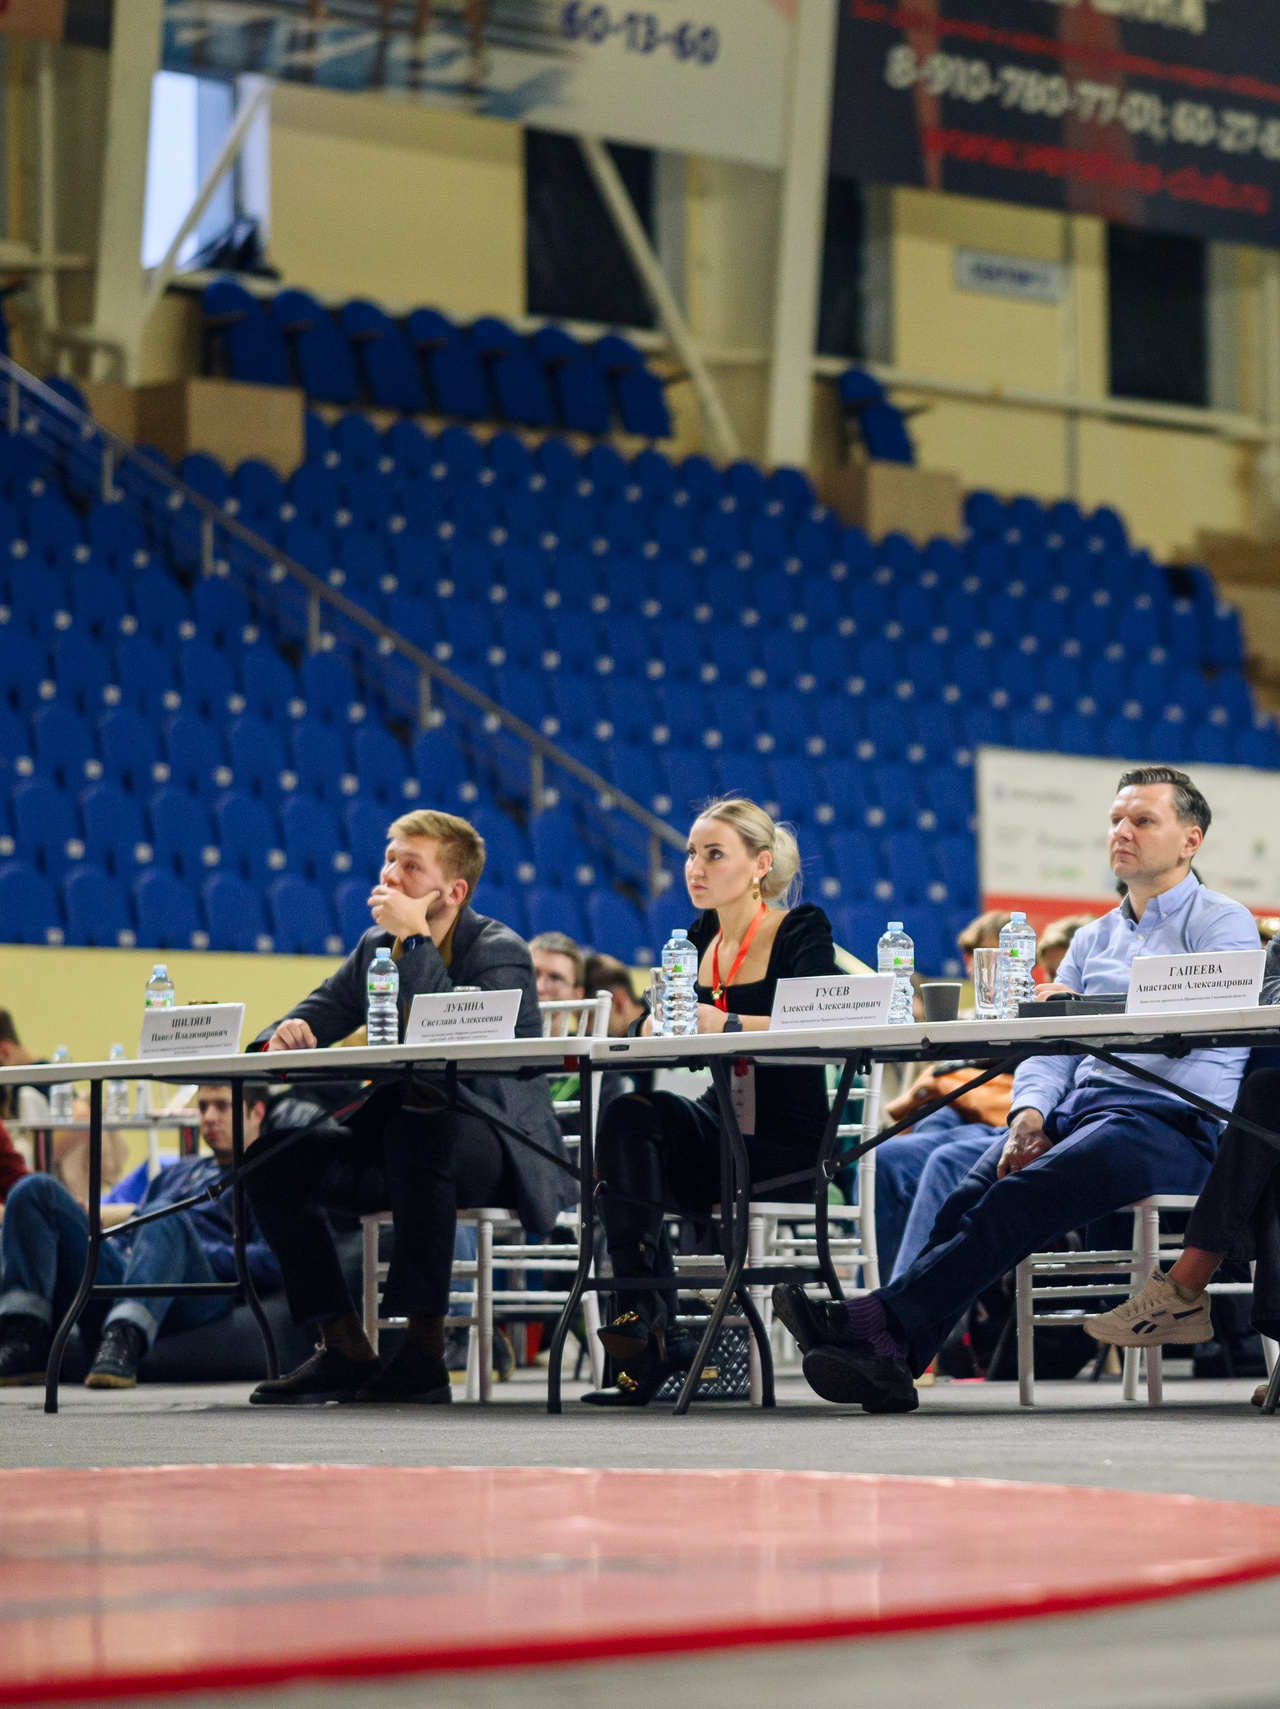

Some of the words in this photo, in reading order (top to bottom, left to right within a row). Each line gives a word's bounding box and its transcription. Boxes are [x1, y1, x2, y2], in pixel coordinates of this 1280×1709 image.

[1169, 964, 1223, 977] ГАПЕЕВА
[815, 986, 850, 997] ГУСЕВ
[1136, 983, 1183, 993] Анастасия
[1184, 978, 1253, 990] Александровна
[443, 1001, 485, 1013] ЛУКИНА
[780, 1002, 815, 1013] Алексей
[816, 1000, 881, 1011] Александрович
[171, 1016, 212, 1028] ШИЛЯЕВ
[421, 1018, 457, 1028] Светлана
[458, 1015, 503, 1025] Алексеевна
[151, 1032, 174, 1042] Павел
[174, 1029, 228, 1040] Владимирович
